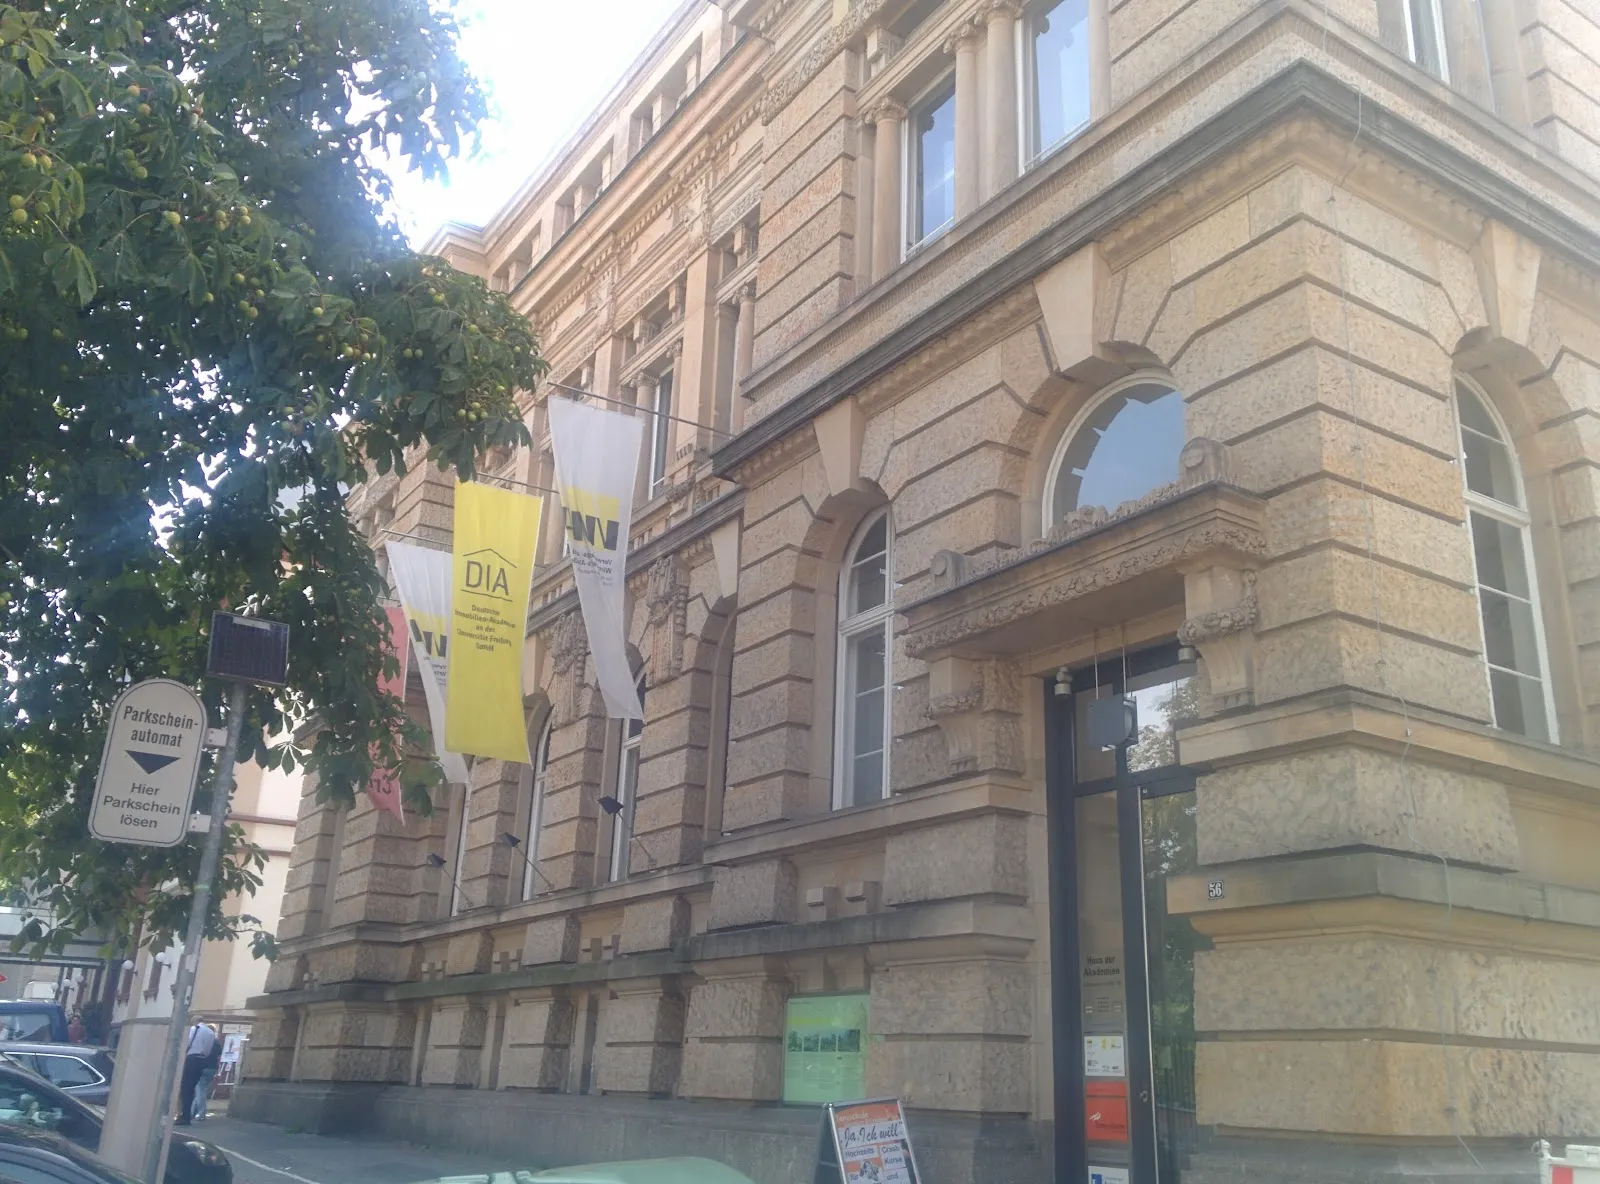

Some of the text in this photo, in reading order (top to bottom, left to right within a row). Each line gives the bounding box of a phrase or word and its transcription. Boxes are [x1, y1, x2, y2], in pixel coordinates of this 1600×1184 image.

[465, 560, 510, 596] DIA
[123, 705, 199, 731] Parkschein-
[130, 729, 183, 748] automat
[130, 782, 161, 796] Hier
[103, 795, 181, 816] Parkschein
[120, 814, 158, 829] lösen
[1209, 882, 1222, 897] 56
